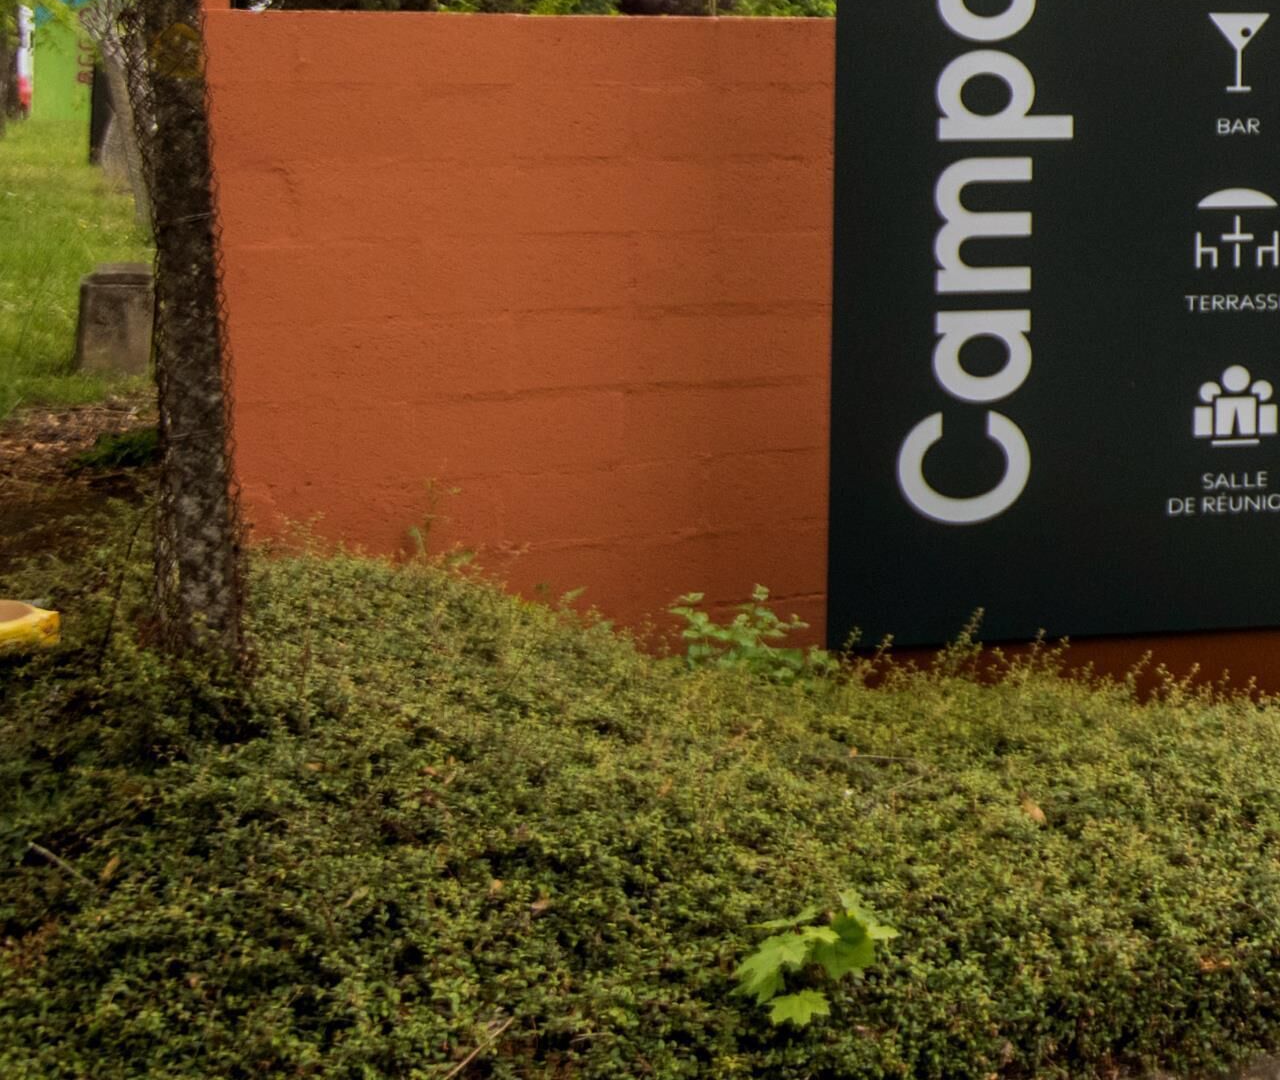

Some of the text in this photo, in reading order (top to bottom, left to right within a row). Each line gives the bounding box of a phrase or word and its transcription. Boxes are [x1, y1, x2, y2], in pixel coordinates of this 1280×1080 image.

[1217, 118, 1260, 134] BAR
[1202, 471, 1268, 490] SALLE
[1167, 497, 1196, 515] DE
